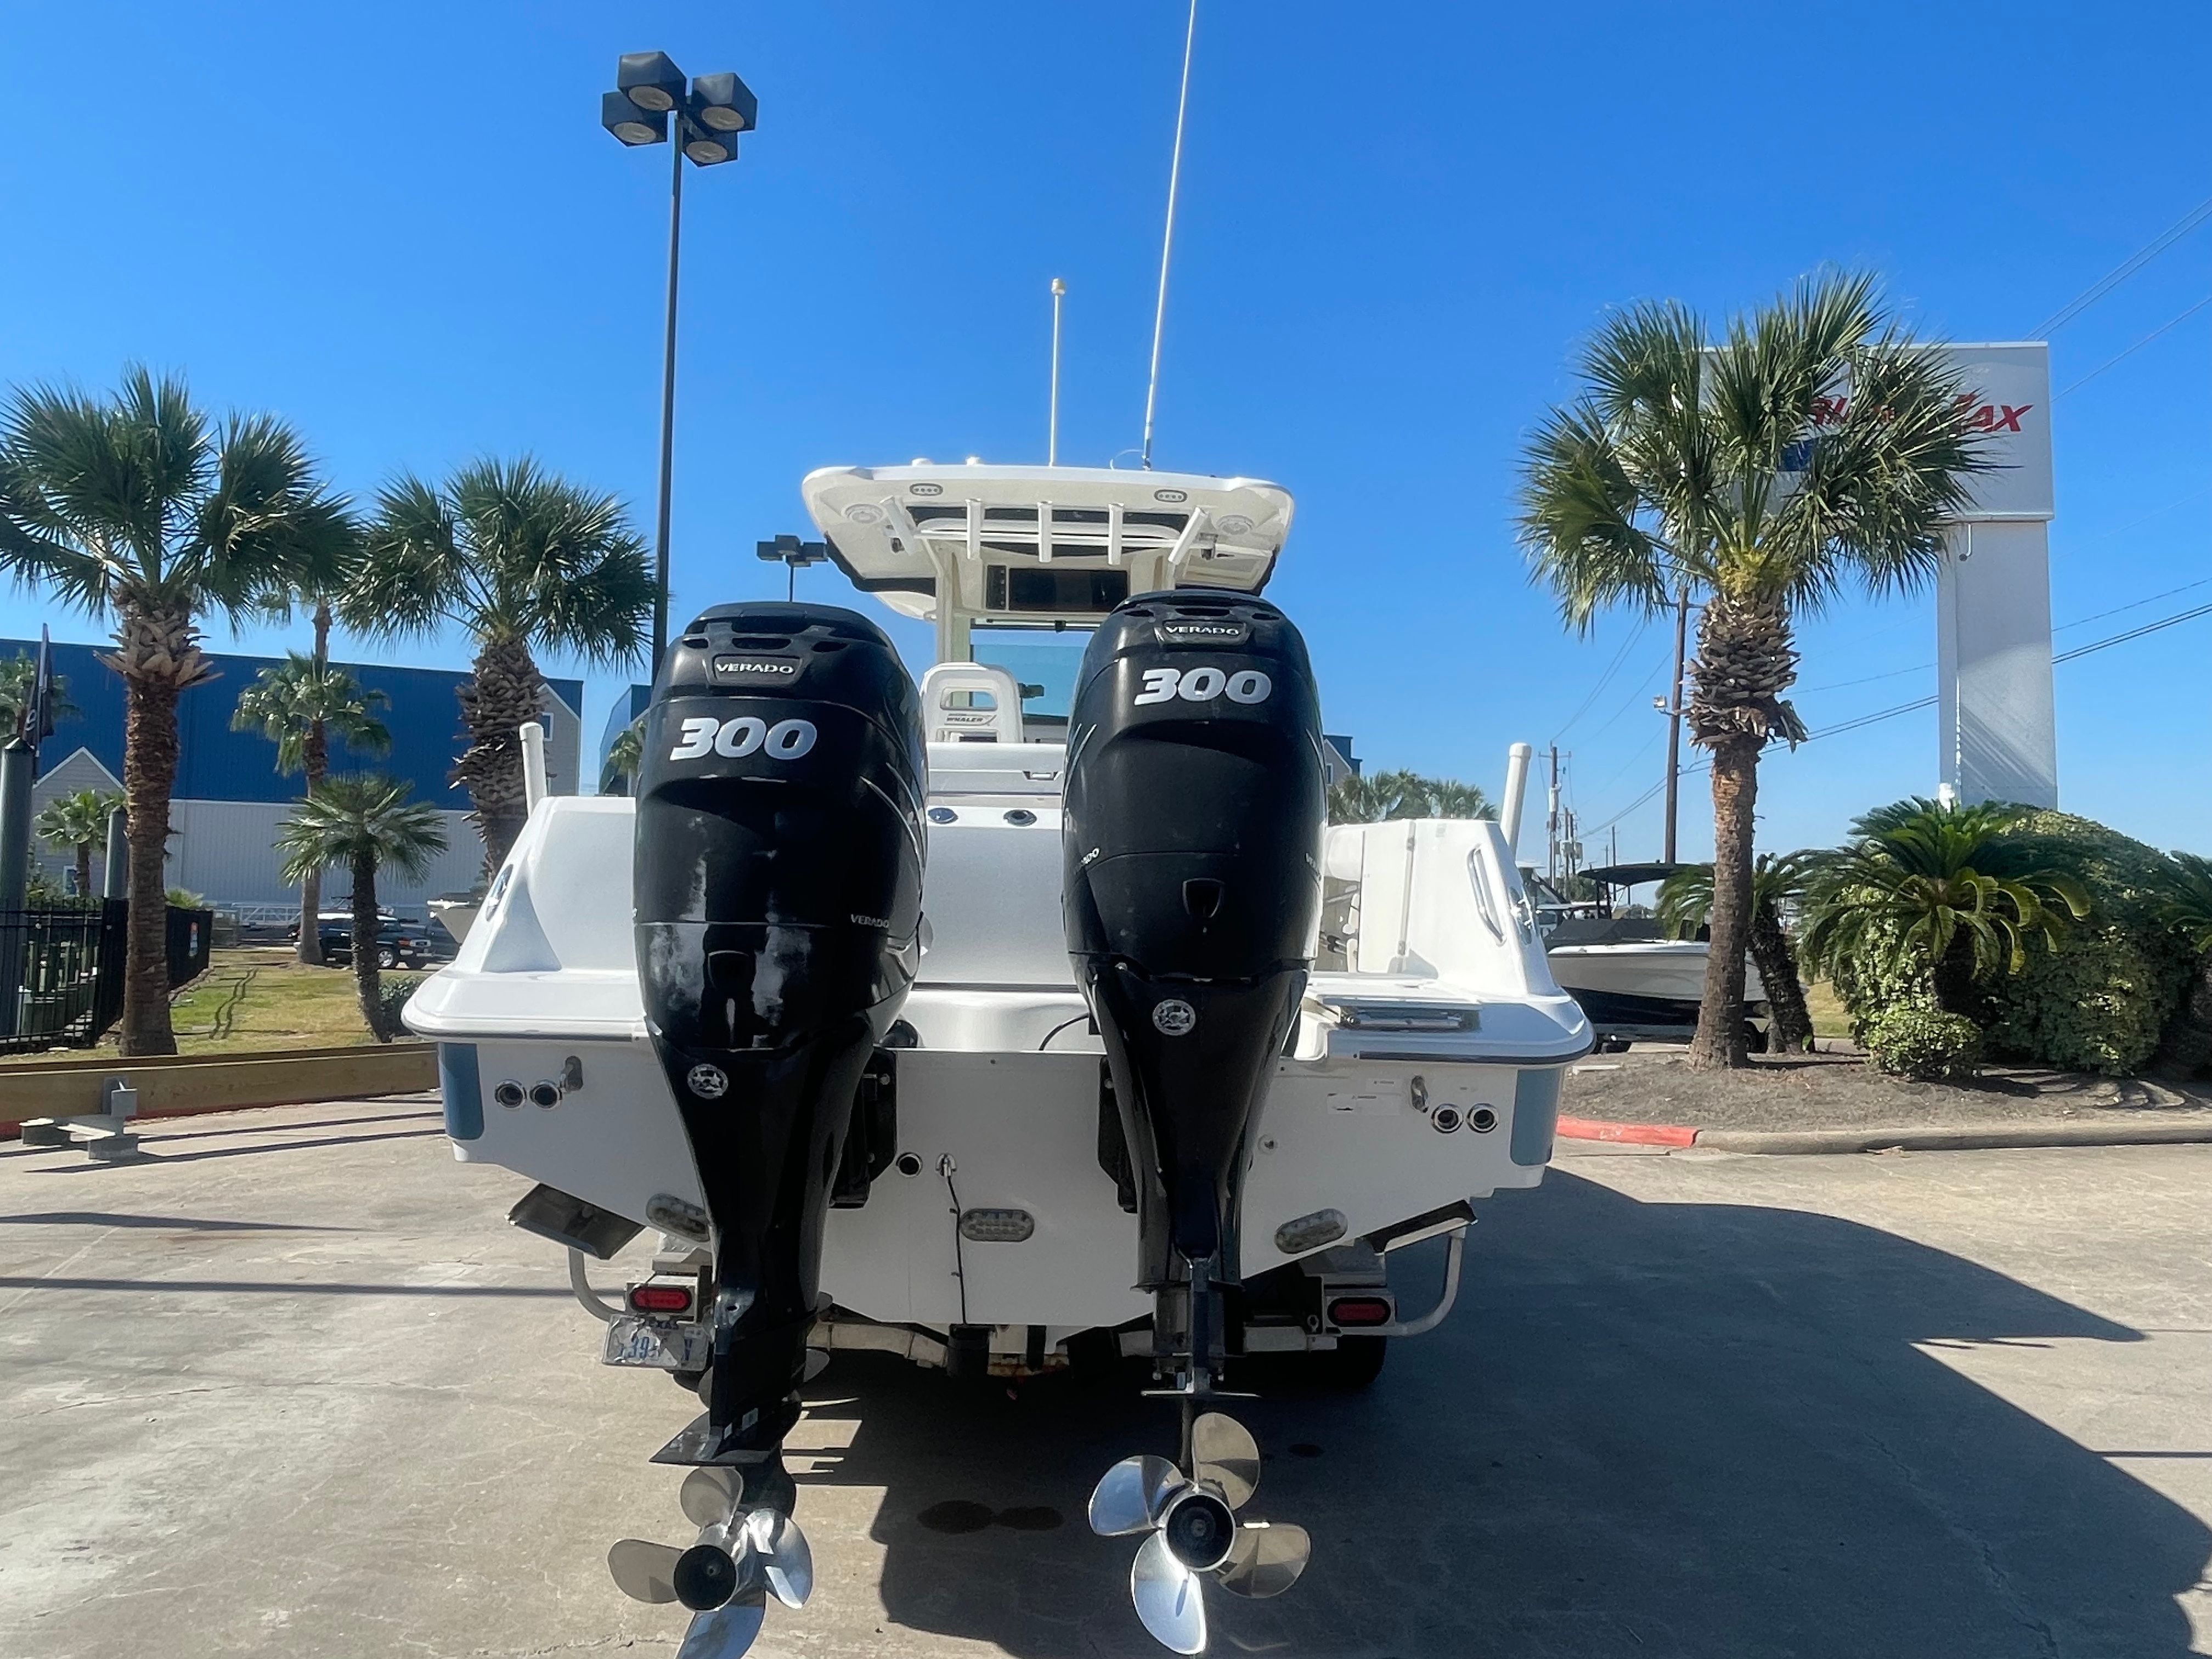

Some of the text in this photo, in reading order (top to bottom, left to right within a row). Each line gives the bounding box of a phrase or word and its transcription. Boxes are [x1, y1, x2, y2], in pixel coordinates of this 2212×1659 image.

[1165, 625, 1239, 635] VERADO
[715, 663, 795, 674] VERADO
[1134, 667, 1272, 706] 300
[669, 716, 817, 761] 300
[851, 914, 889, 928] VERADO
